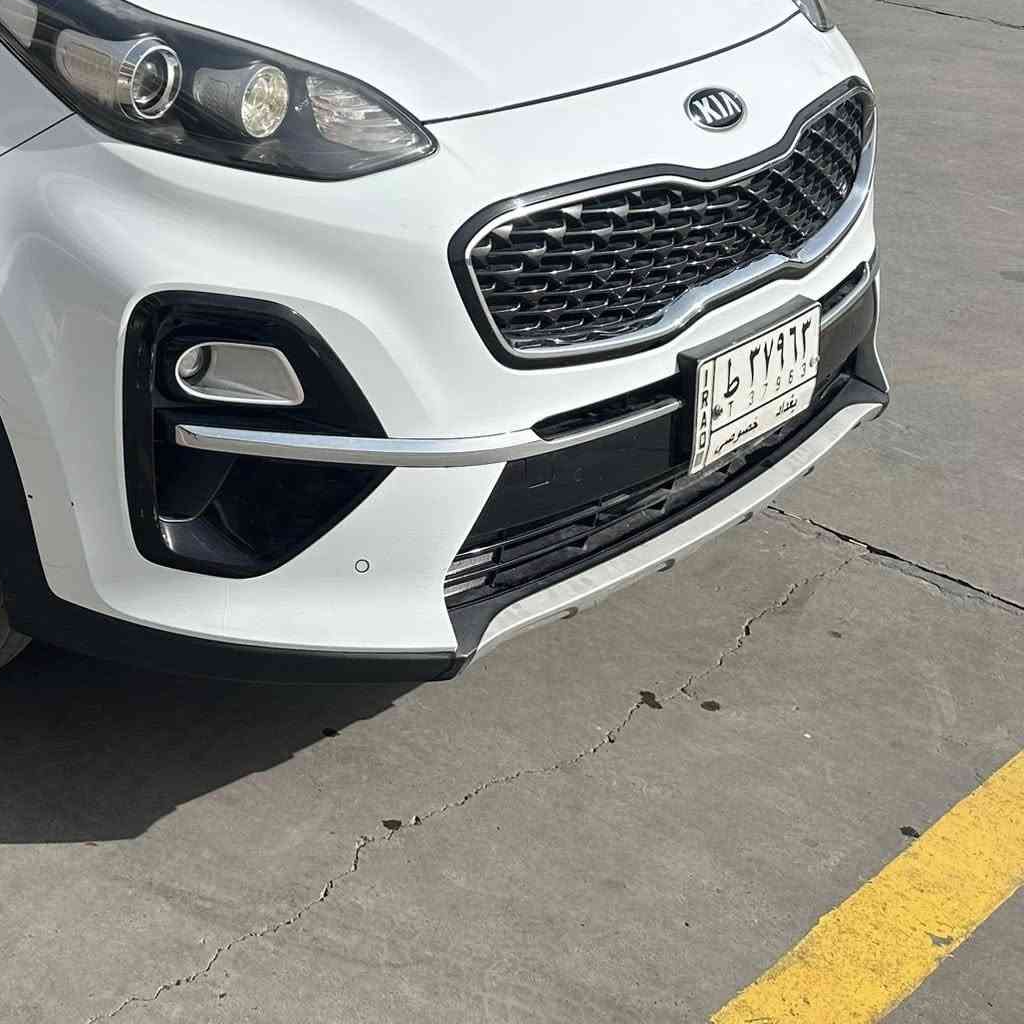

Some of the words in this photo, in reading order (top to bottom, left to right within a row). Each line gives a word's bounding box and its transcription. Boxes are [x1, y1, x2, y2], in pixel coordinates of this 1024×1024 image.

[692, 91, 741, 124] KIA
[749, 320, 811, 387] ٣٧٩٦٣
[749, 362, 806, 406] 37963
